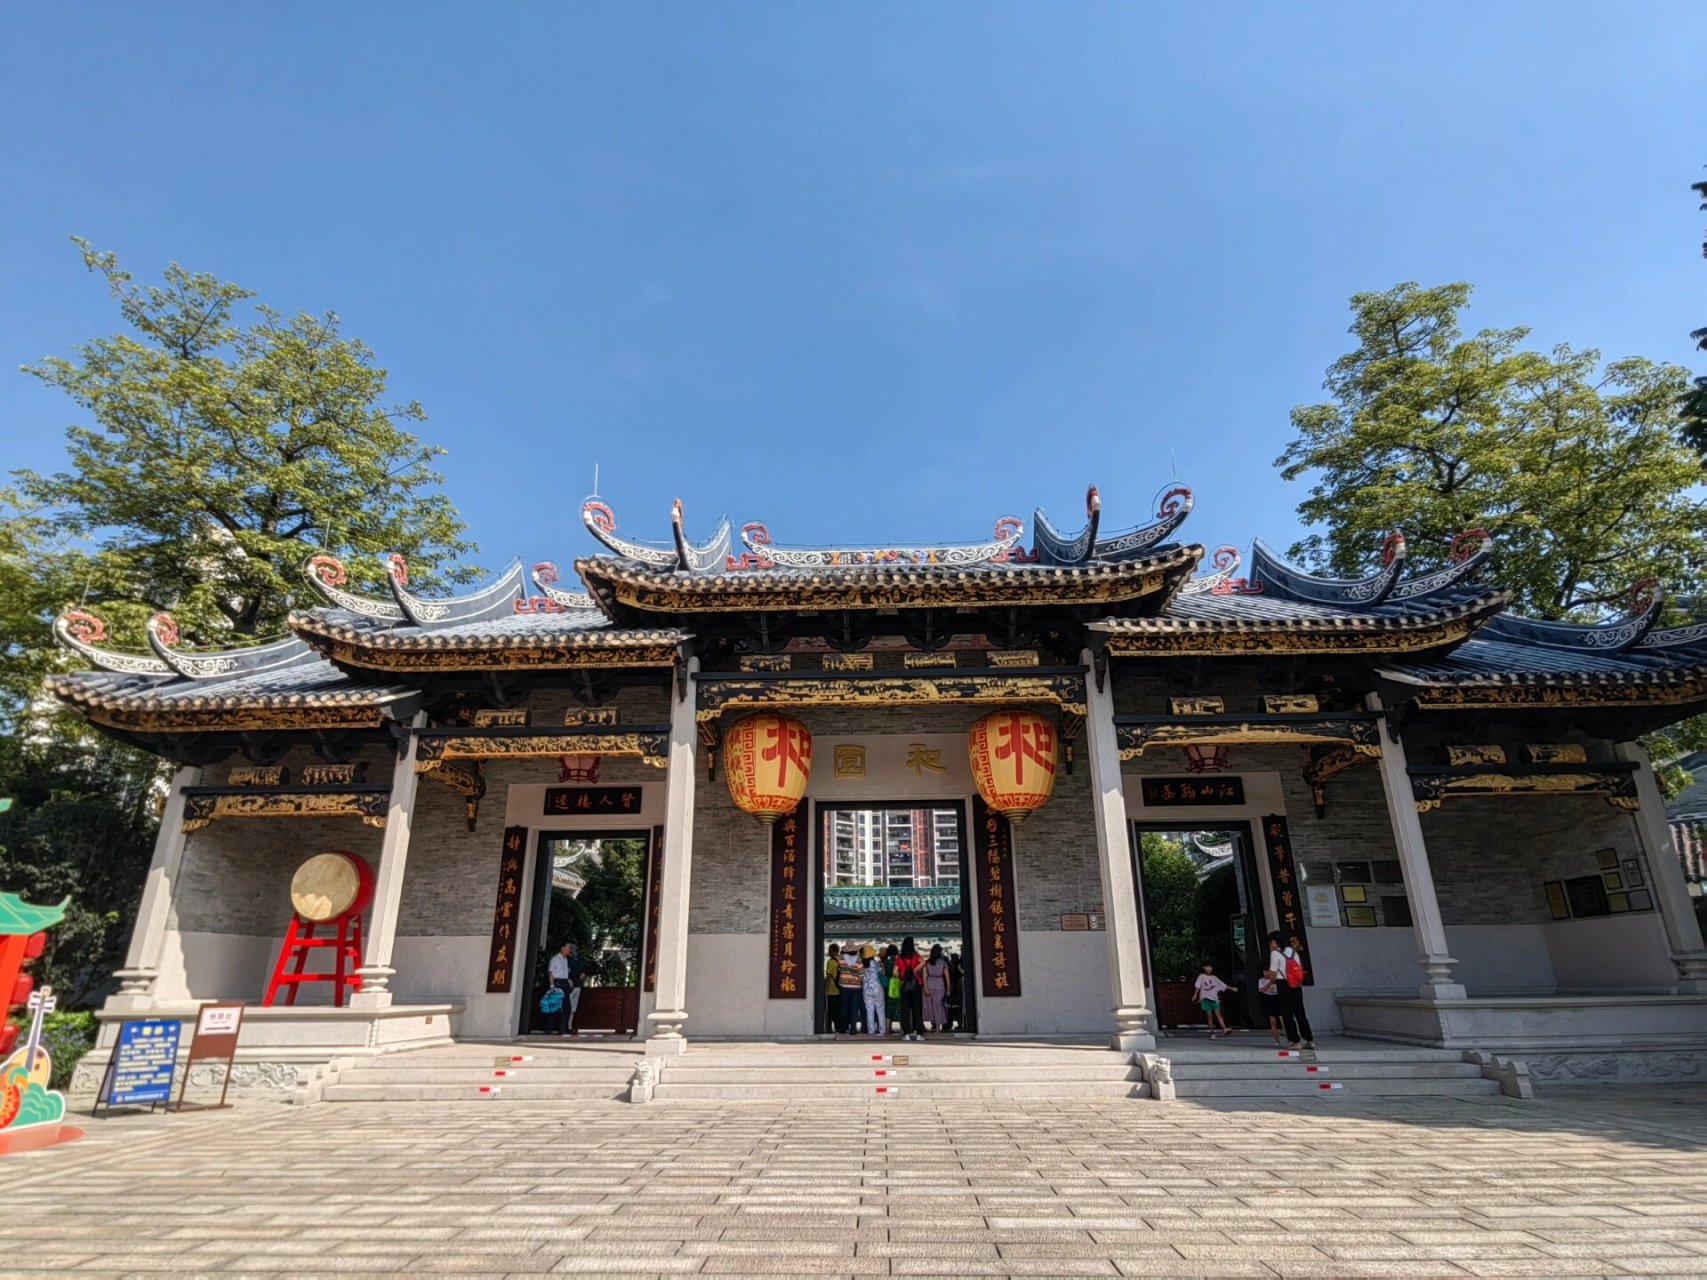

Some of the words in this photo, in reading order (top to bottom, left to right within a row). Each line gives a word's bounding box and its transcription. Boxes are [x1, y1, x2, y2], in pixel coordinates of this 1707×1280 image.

[761, 713, 811, 788] 和
[833, 743, 948, 779] 和園
[996, 711, 1055, 785] 和
[1269, 823, 1307, 973] 彩筆昔曾干氣
